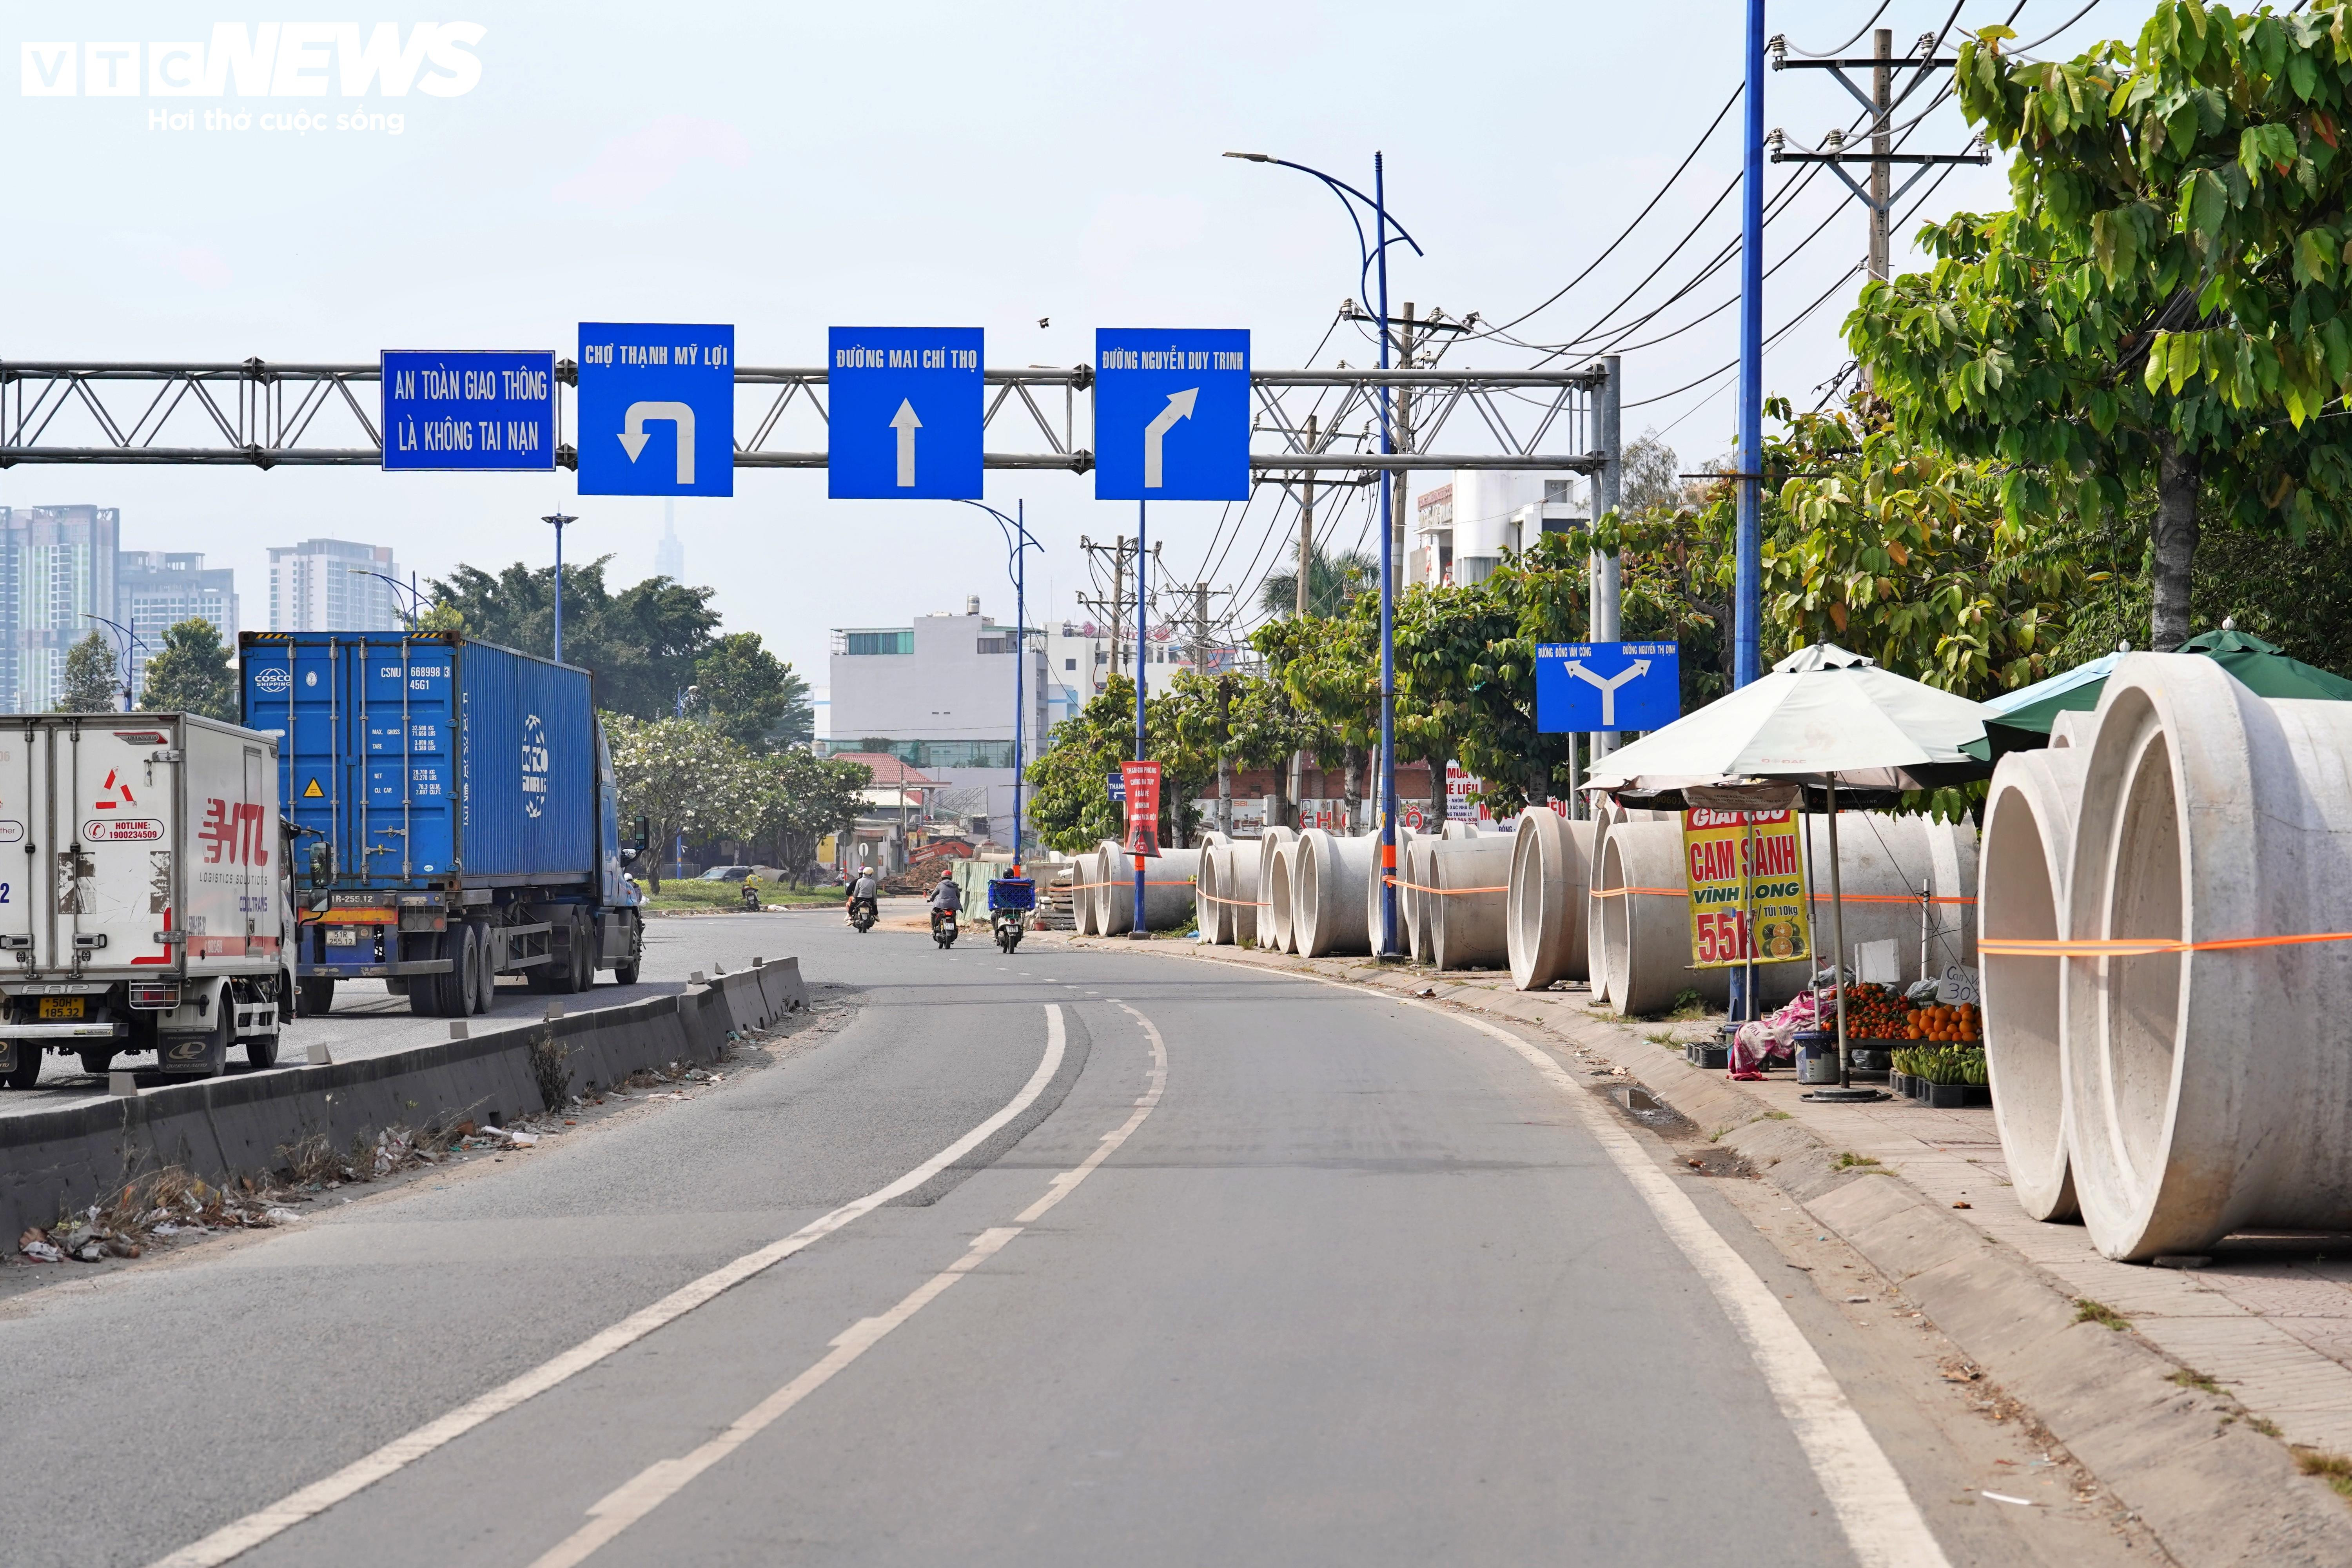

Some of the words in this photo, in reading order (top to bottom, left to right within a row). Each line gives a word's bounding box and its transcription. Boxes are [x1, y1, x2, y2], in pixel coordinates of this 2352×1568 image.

[585, 343, 614, 368] CHỢ
[620, 346, 668, 368] THẠNH
[675, 344, 697, 365] MỸ
[704, 345, 727, 370] LỢI
[836, 345, 884, 368] ĐƯỜNG
[889, 350, 918, 368] MAI
[922, 347, 945, 368] CHÍ
[951, 350, 977, 373] THỌ
[1102, 347, 1138, 370] ĐƯỜNG
[1141, 345, 1185, 370] NGUYỄN
[1189, 352, 1210, 369] DUY
[1213, 352, 1243, 370] TRINH
[395, 370, 415, 399] AN
[422, 363, 461, 399] TOÀN
[465, 370, 495, 400] GIAO
[504, 366, 547, 400] THÔNG
[398, 414, 418, 451] LÀ
[425, 416, 472, 451] KHÔNG
[479, 421, 501, 450] TAI
[508, 421, 538, 456] NẠN
[1569, 645, 1577, 657] VĂN
[1666, 645, 1676, 657] ĐỊNH
[381, 667, 401, 678] CSNU
[411, 667, 441, 677] 668998
[445, 666, 450, 677] 3
[410, 679, 430, 690] 45G1
[1447, 768, 1468, 779] MUA
[1690, 839, 1737, 884] CAM
[1740, 828, 1798, 878] SÀNH
[200, 871, 233, 884] LOGISTICS
[236, 874, 268, 886] SOLUTIONS
[1693, 885, 1740, 904] VĨNH
[1744, 882, 1800, 901] LONG
[1763, 904, 1777, 918] TÚI
[1778, 906, 1798, 918] 10kg
[1697, 909, 1762, 964] 55K
[53, 998, 72, 1007] 50H
[45, 1008, 79, 1017] 185.32
